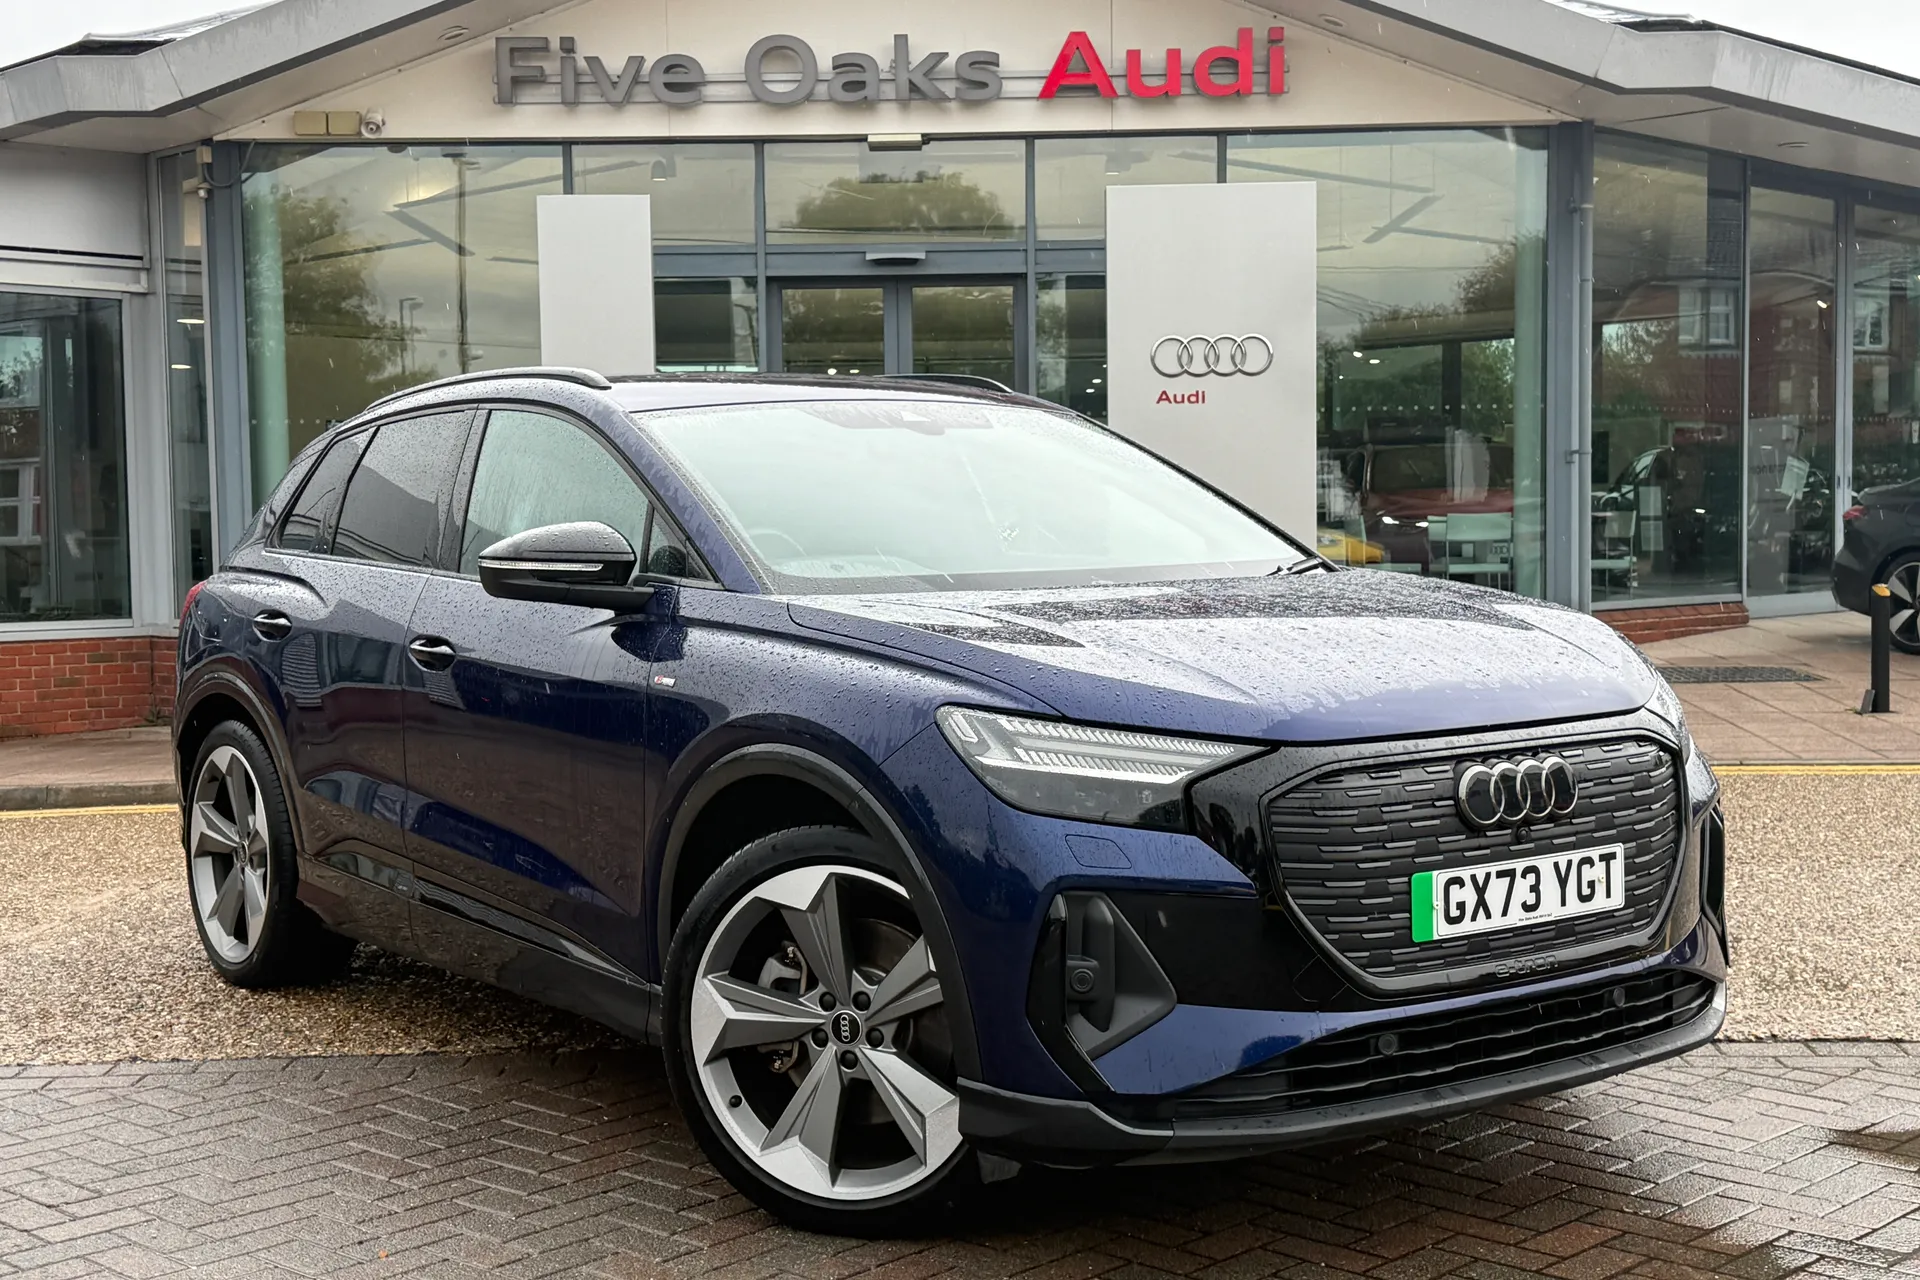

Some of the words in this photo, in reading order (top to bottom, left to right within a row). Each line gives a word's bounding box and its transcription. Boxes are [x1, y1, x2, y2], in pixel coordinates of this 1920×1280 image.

[495, 36, 706, 105] Five
[744, 33, 1003, 104] Oaks
[1038, 26, 1285, 100] Audi
[1155, 389, 1206, 405] Audi
[1443, 864, 1542, 926] GX73
[1552, 851, 1618, 908] YGT
[1494, 954, 1560, 978] e-tron
